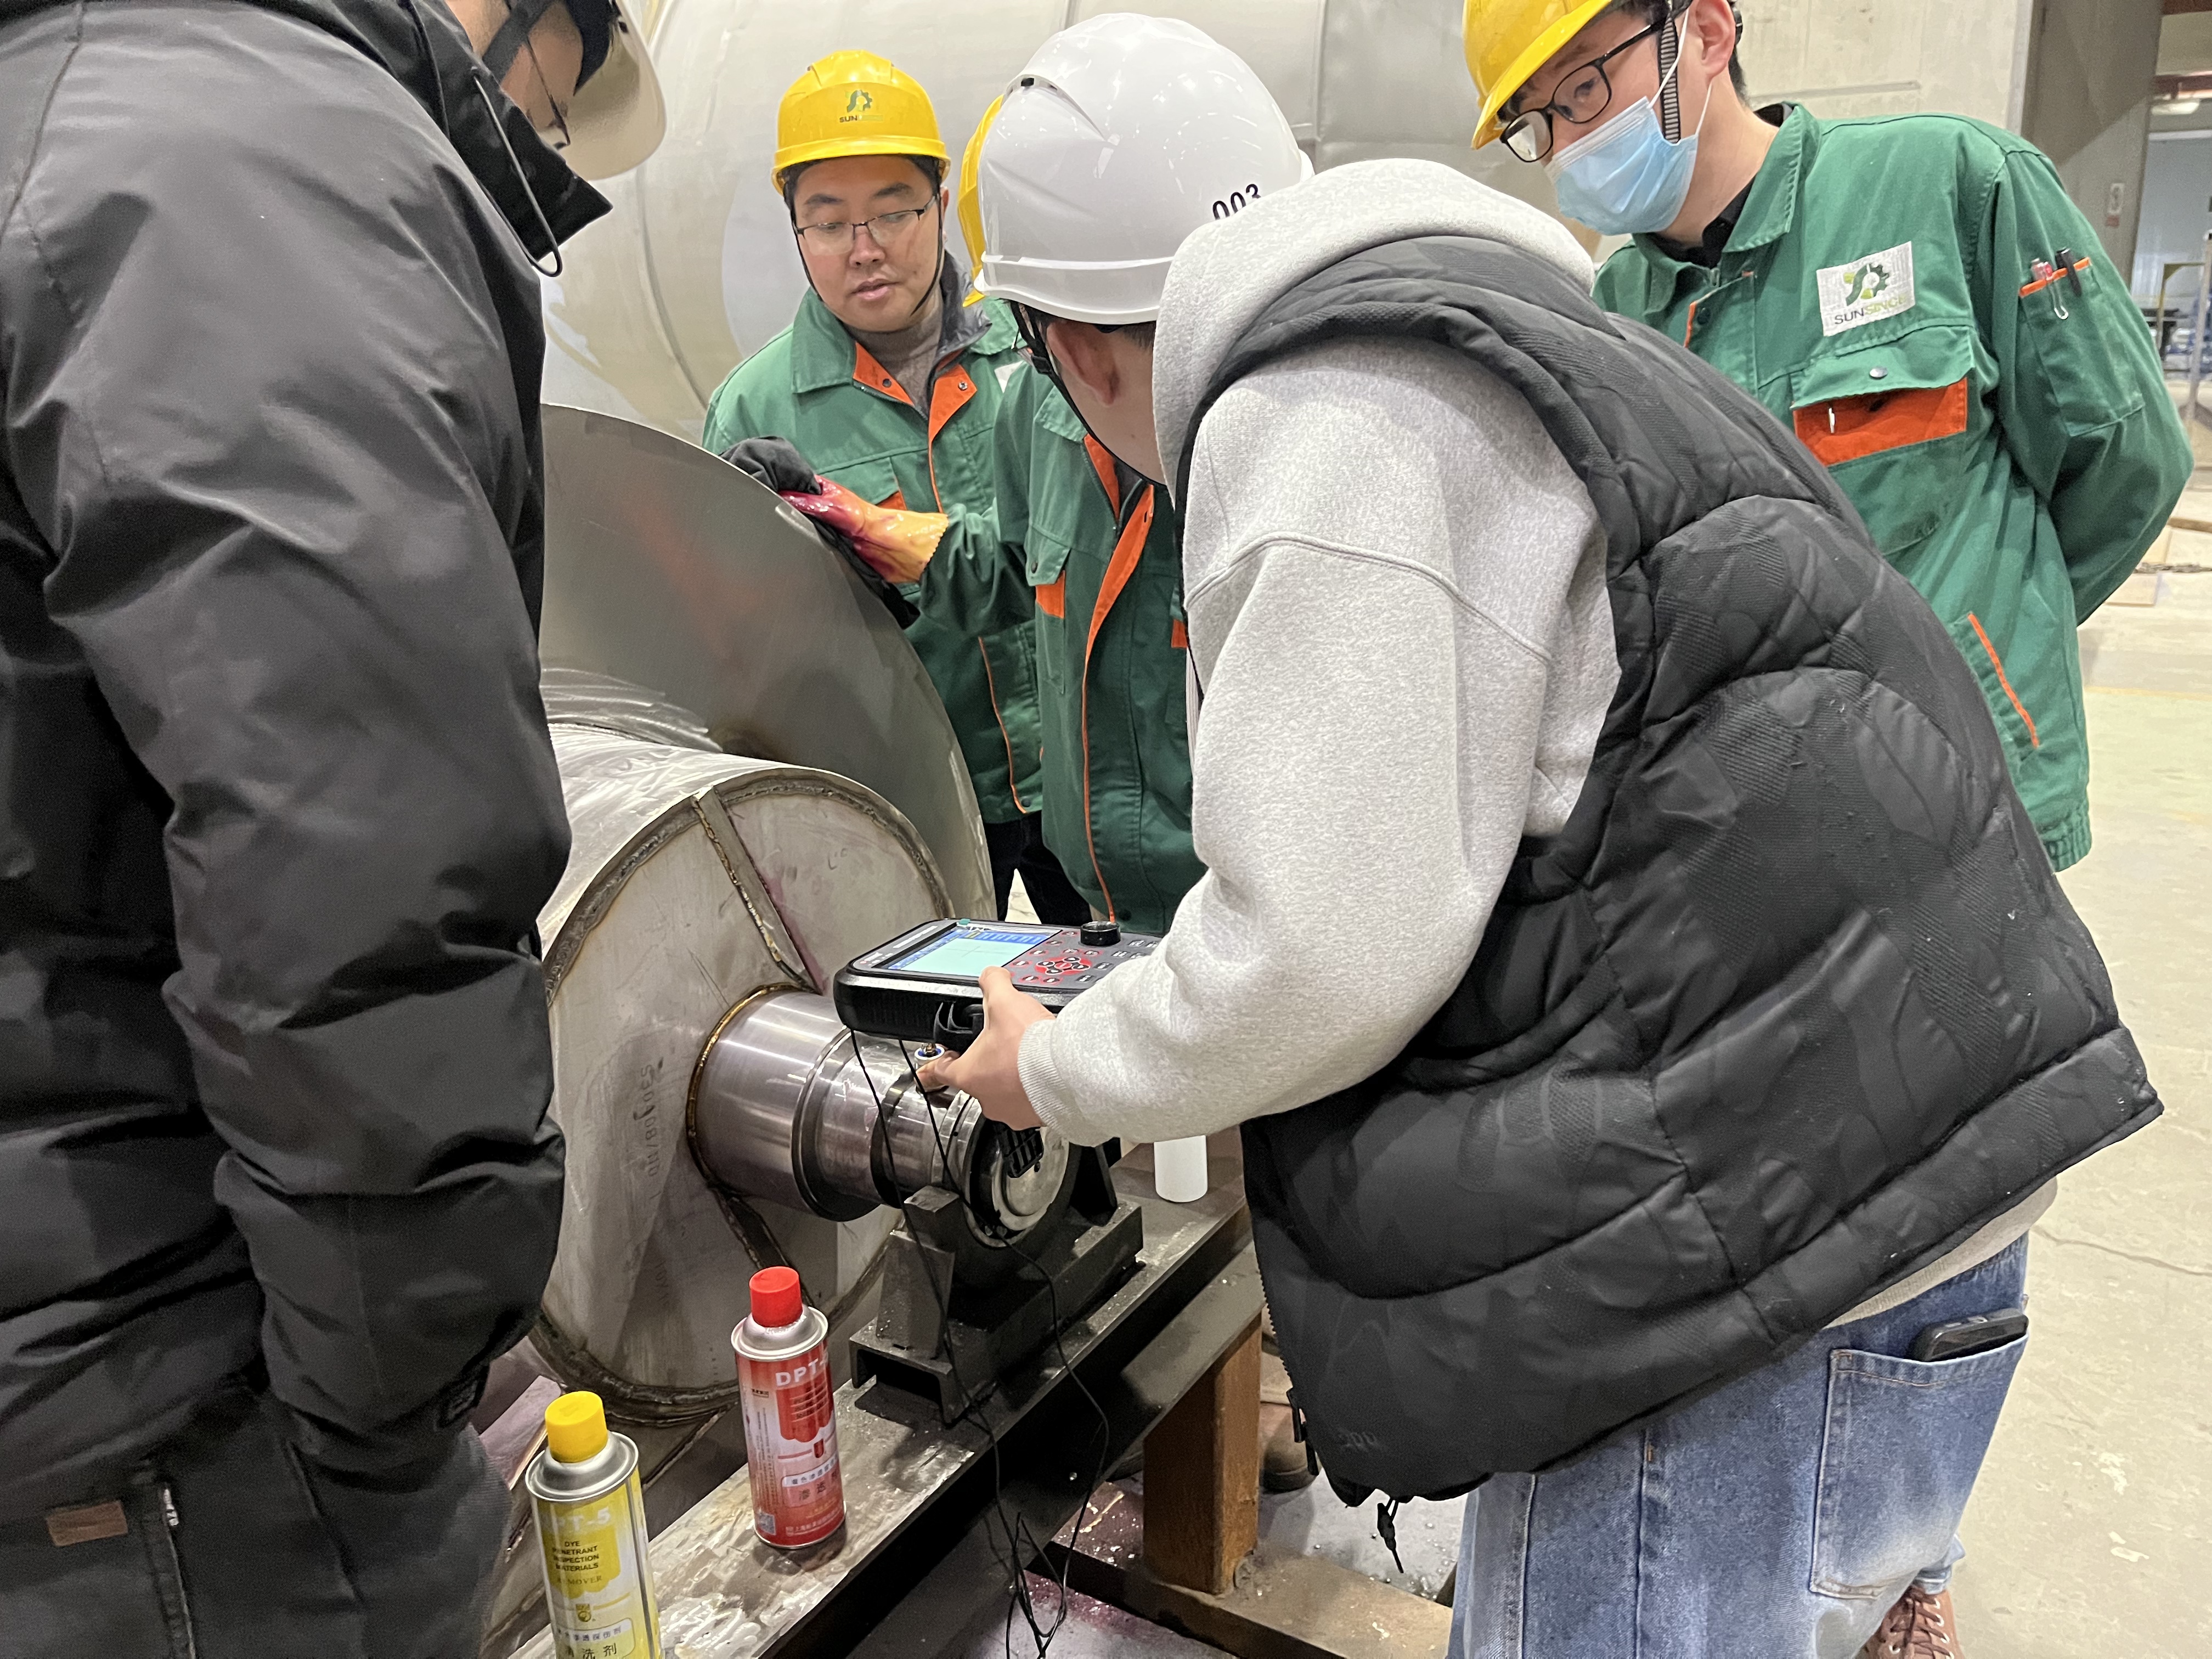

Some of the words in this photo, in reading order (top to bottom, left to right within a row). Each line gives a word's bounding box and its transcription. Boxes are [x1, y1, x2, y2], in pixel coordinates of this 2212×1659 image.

[543, 1506, 611, 1532] PT-5
[552, 1545, 598, 1555] PNETRANT
[557, 1575, 602, 1585] RMOVER
